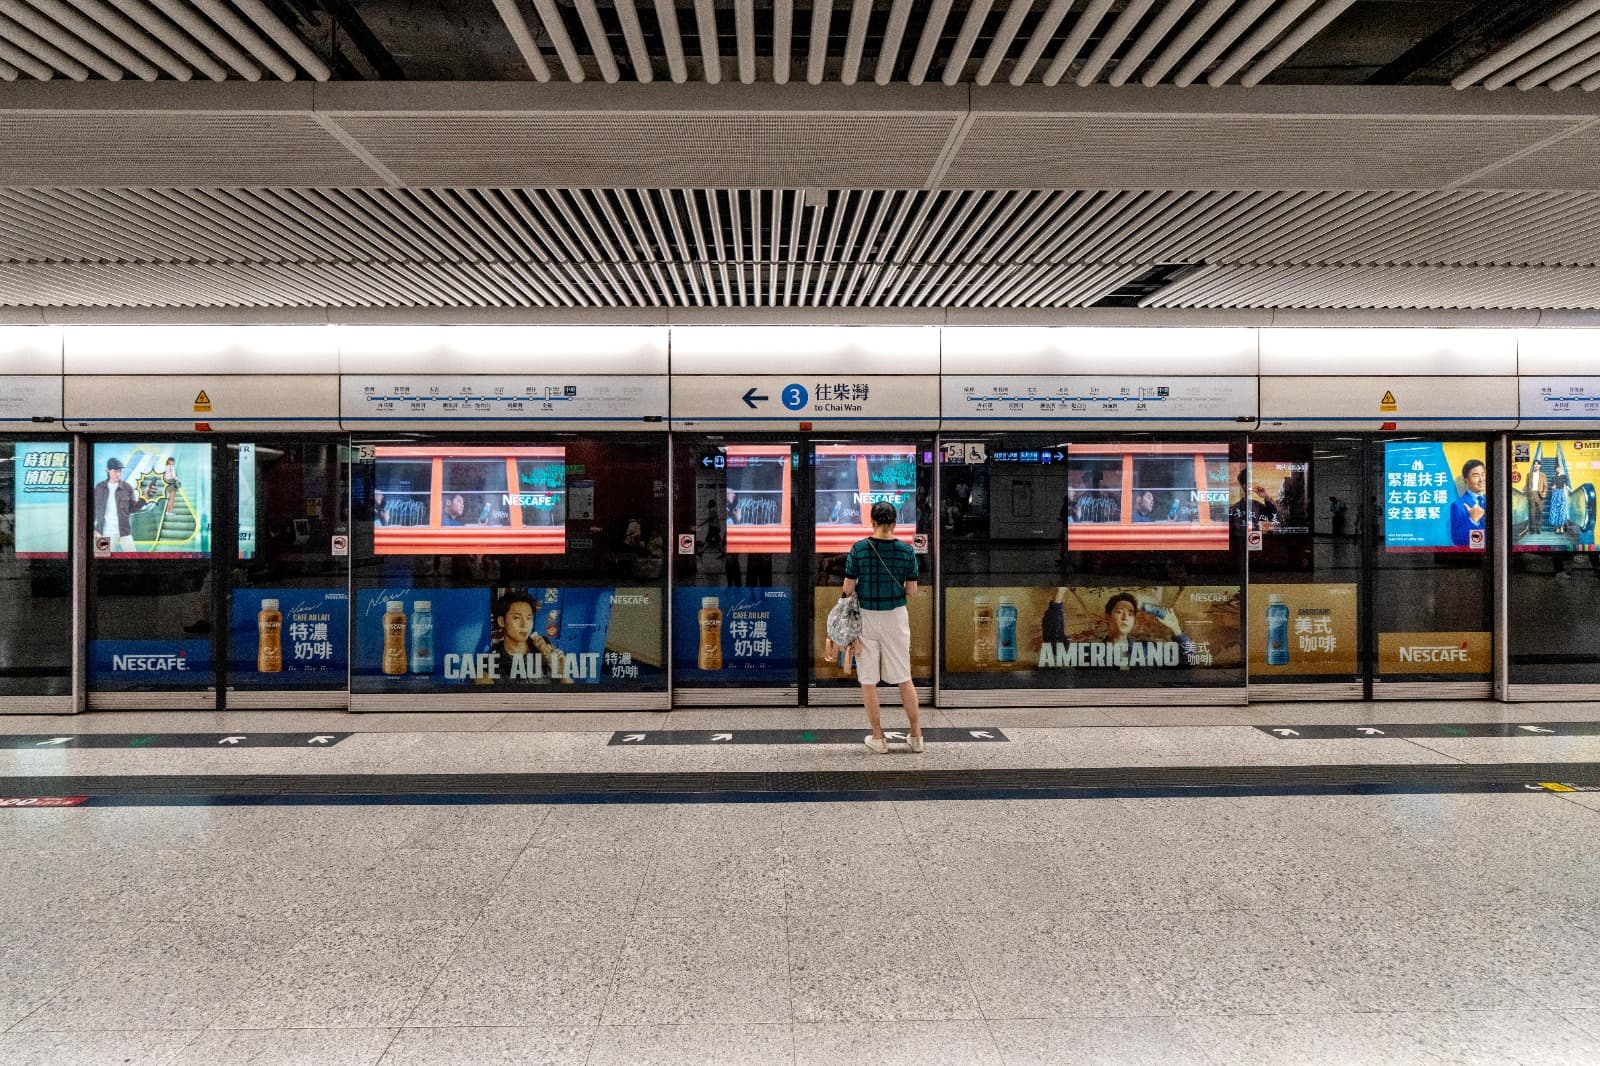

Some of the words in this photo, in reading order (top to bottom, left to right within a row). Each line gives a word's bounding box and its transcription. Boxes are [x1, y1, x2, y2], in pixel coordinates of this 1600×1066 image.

[789, 388, 801, 406] 3
[815, 383, 869, 402] 往柴灣
[814, 403, 821, 411] to
[824, 403, 843, 411] Chai
[844, 403, 862, 411] Wan
[361, 447, 376, 458] 5-2
[1387, 472, 1448, 488] 緊握扶手
[1388, 490, 1448, 504] 左右企穩
[1388, 507, 1441, 520] 安全要緊
[289, 622, 329, 641] 特濃
[729, 620, 768, 639] 特濃
[1295, 616, 1333, 635] 美式
[294, 641, 333, 660] 奶啡
[734, 639, 773, 657] 奶啡
[1183, 640, 1210, 654] 美式
[1299, 634, 1337, 653] 咖啡
[605, 652, 632, 666] 特濃
[1038, 642, 1179, 668] AMERICANO
[1186, 653, 1214, 666] 咖啡
[444, 651, 500, 679] CAFÉ
[510, 653, 544, 679] AU
[551, 653, 600, 679] LAIT
[611, 665, 639, 678] 奶啡
